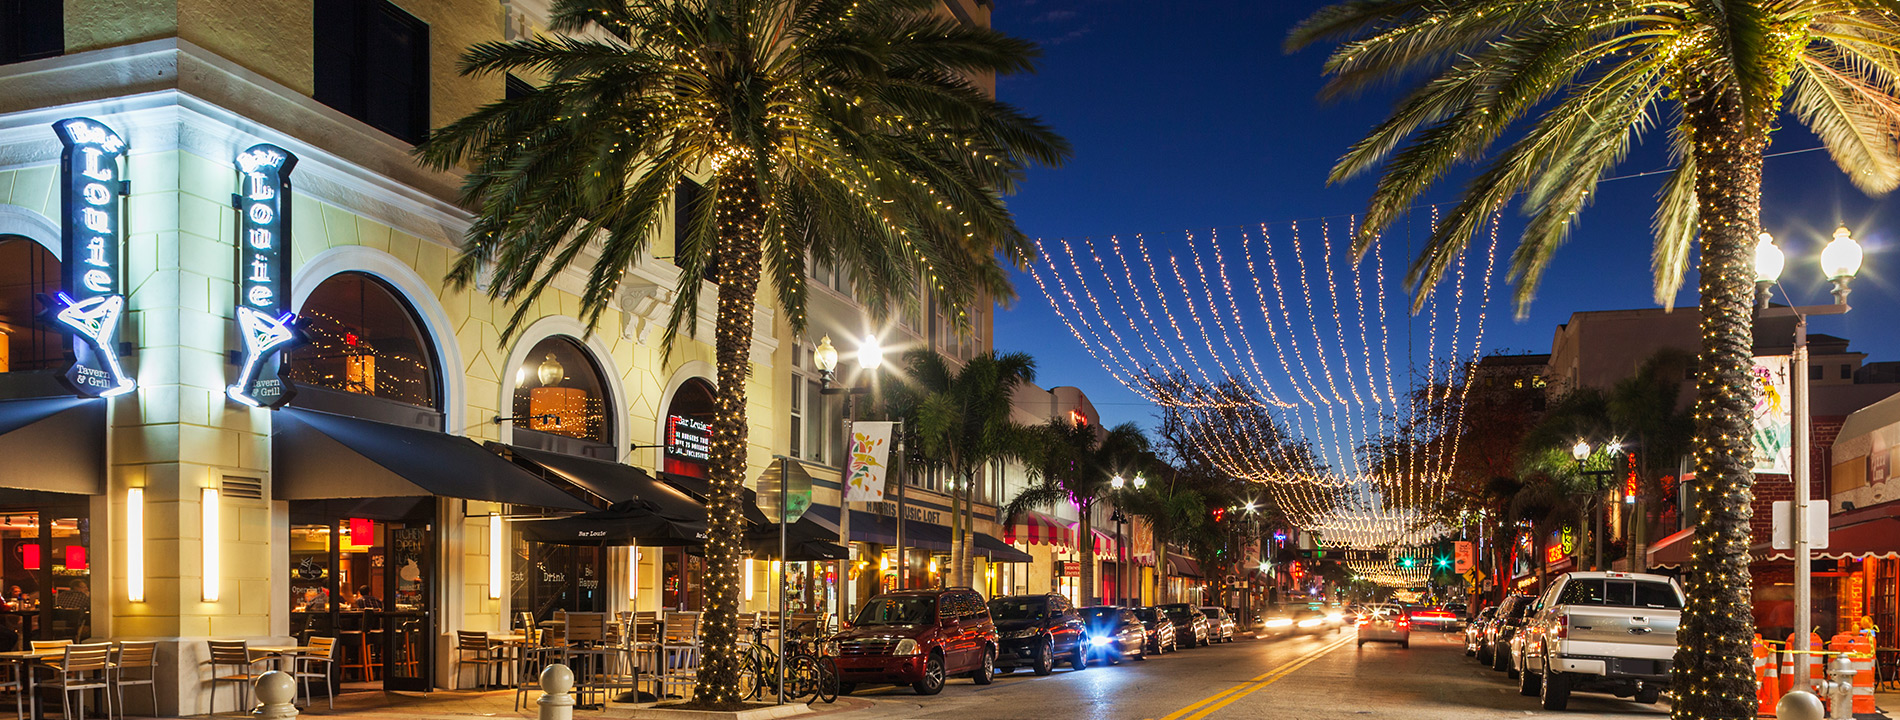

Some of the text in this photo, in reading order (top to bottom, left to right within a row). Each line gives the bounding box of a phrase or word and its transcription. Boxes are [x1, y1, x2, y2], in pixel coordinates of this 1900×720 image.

[67, 121, 125, 154] Bar
[236, 150, 285, 174] Bar
[81, 146, 113, 292] Louie
[248, 171, 275, 307] Louie
[76, 364, 111, 379] Tavern
[76, 374, 111, 389] & Grill
[253, 379, 280, 388] Tavern
[260, 386, 280, 396] Grill
[675, 415, 707, 431] Bar Louie
[904, 506, 922, 521] USIC
[923, 509, 941, 524] LOFT
[510, 571, 565, 582] Eat Drink
[578, 577, 598, 589] Happy
